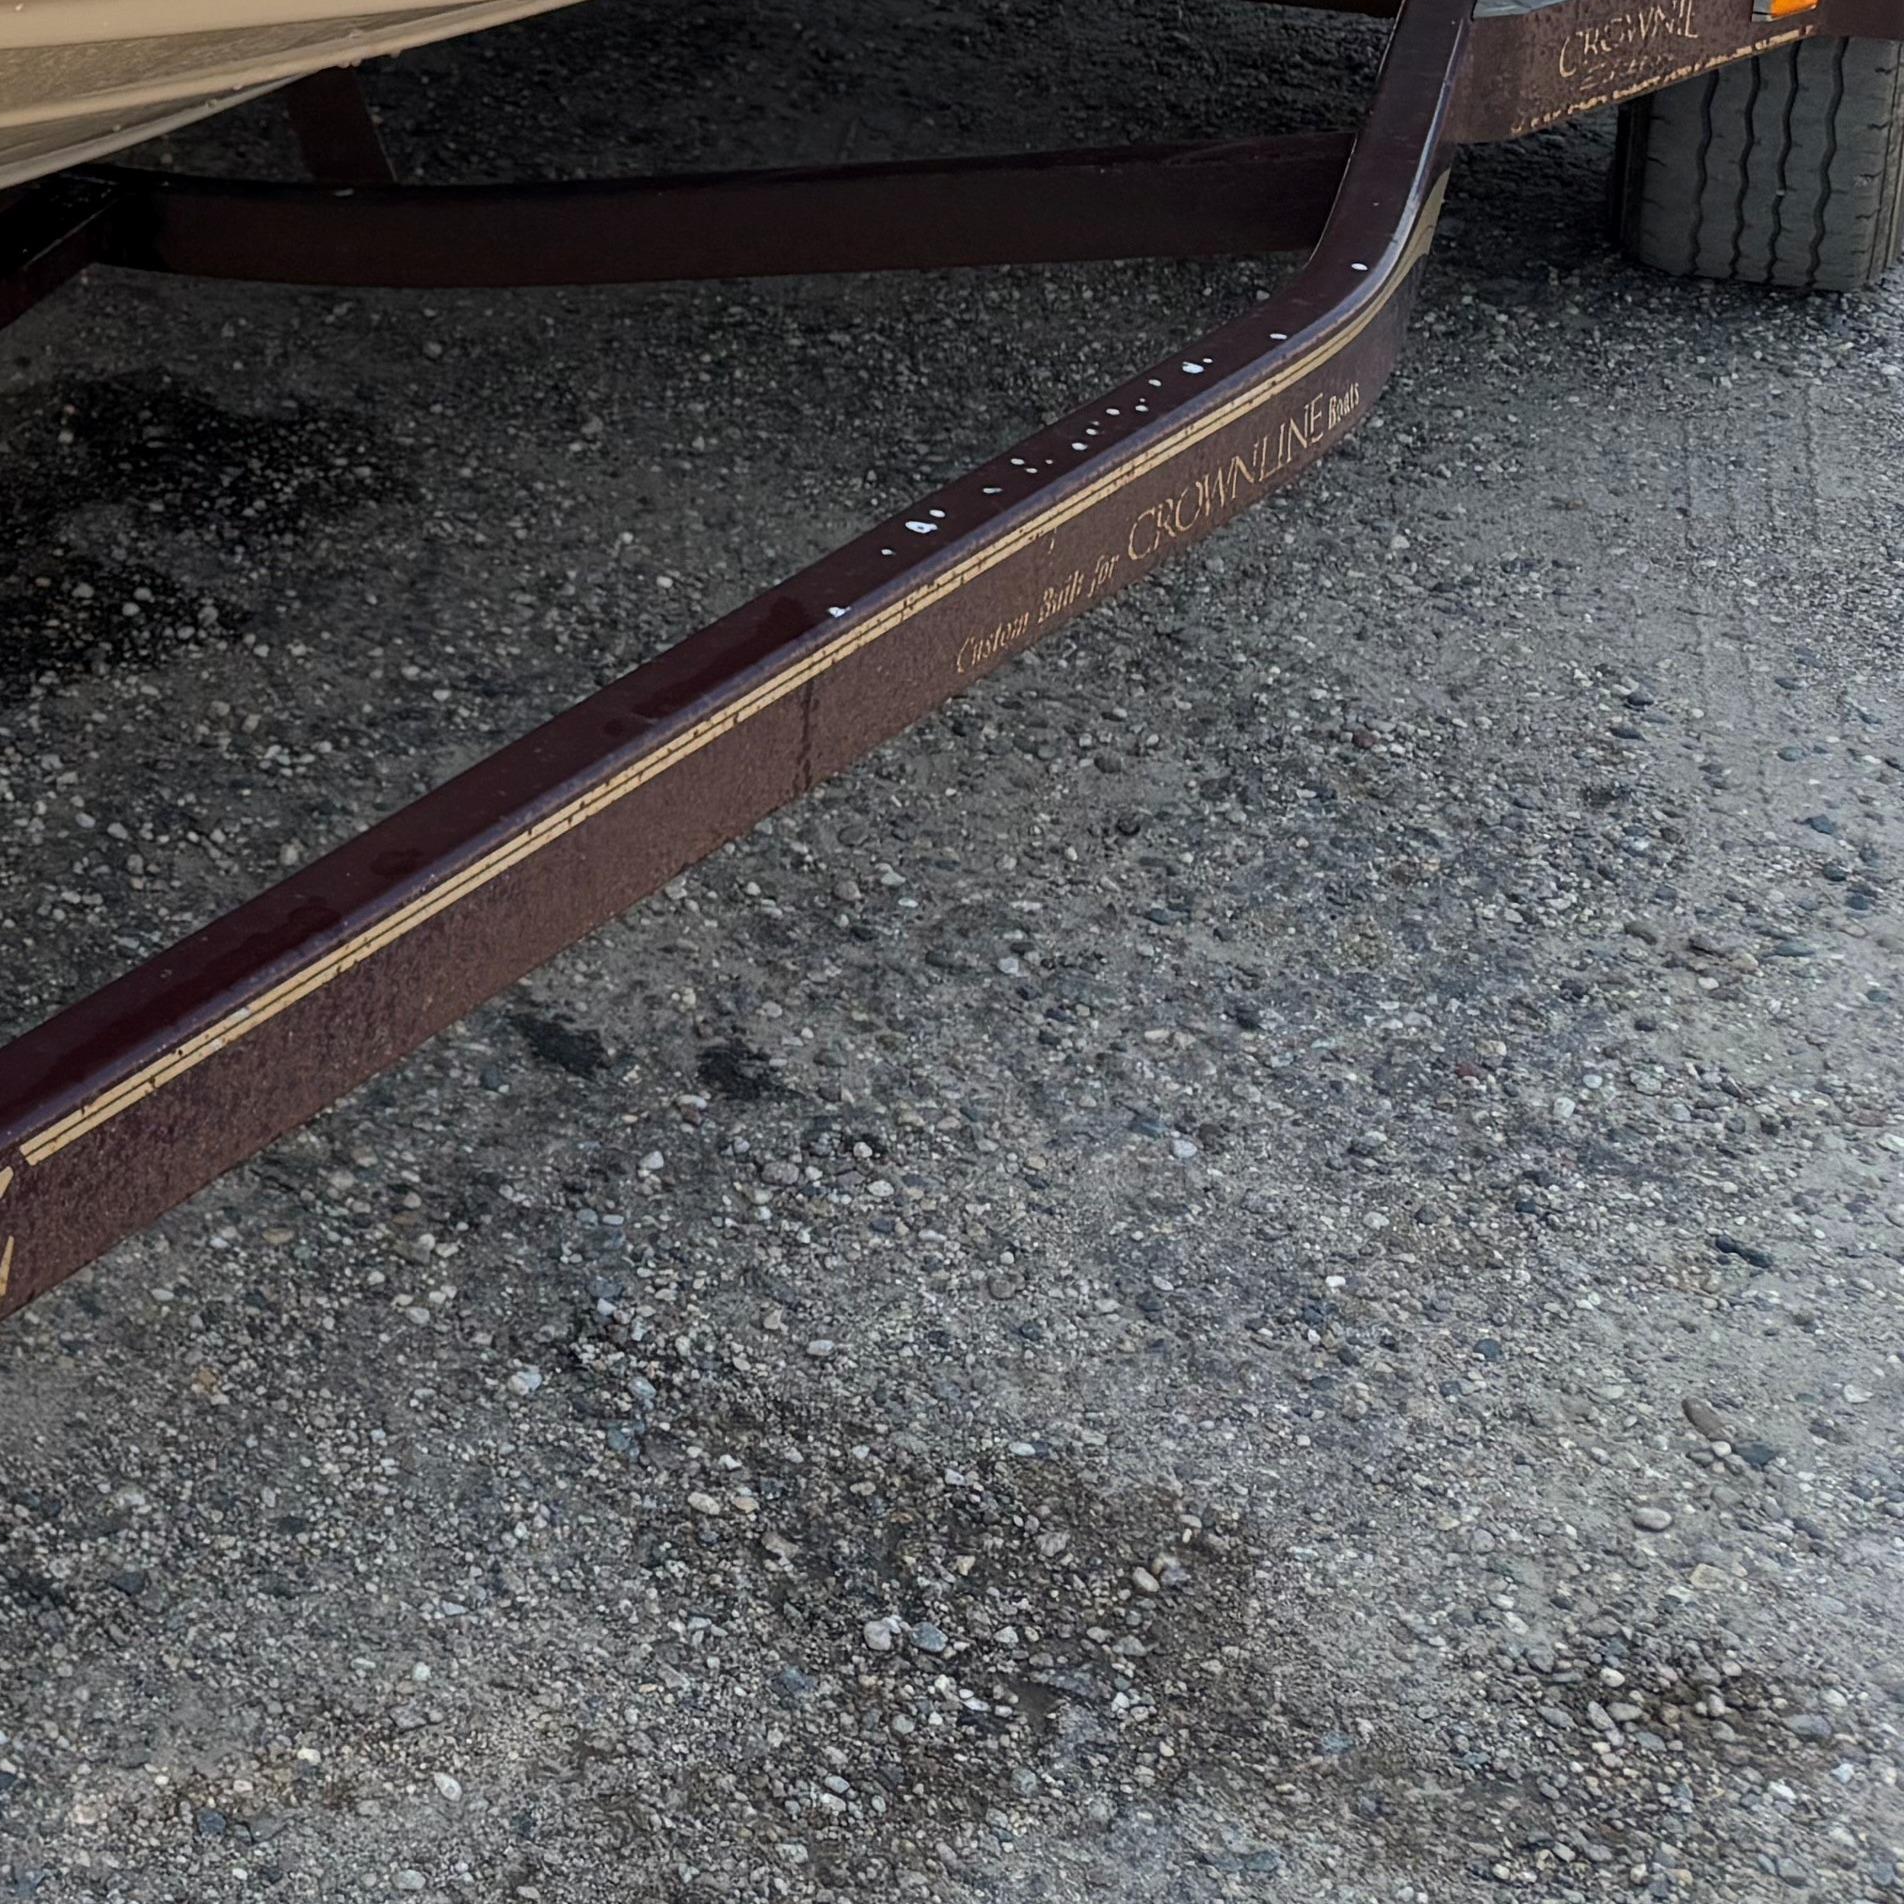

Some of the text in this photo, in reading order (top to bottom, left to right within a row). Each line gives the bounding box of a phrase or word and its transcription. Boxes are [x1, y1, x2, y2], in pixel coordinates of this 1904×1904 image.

[956, 611, 1030, 673] Custom
[1088, 554, 1120, 598] for
[1127, 392, 1324, 560] CROWNLINE
[1328, 382, 1360, 430] Boats
